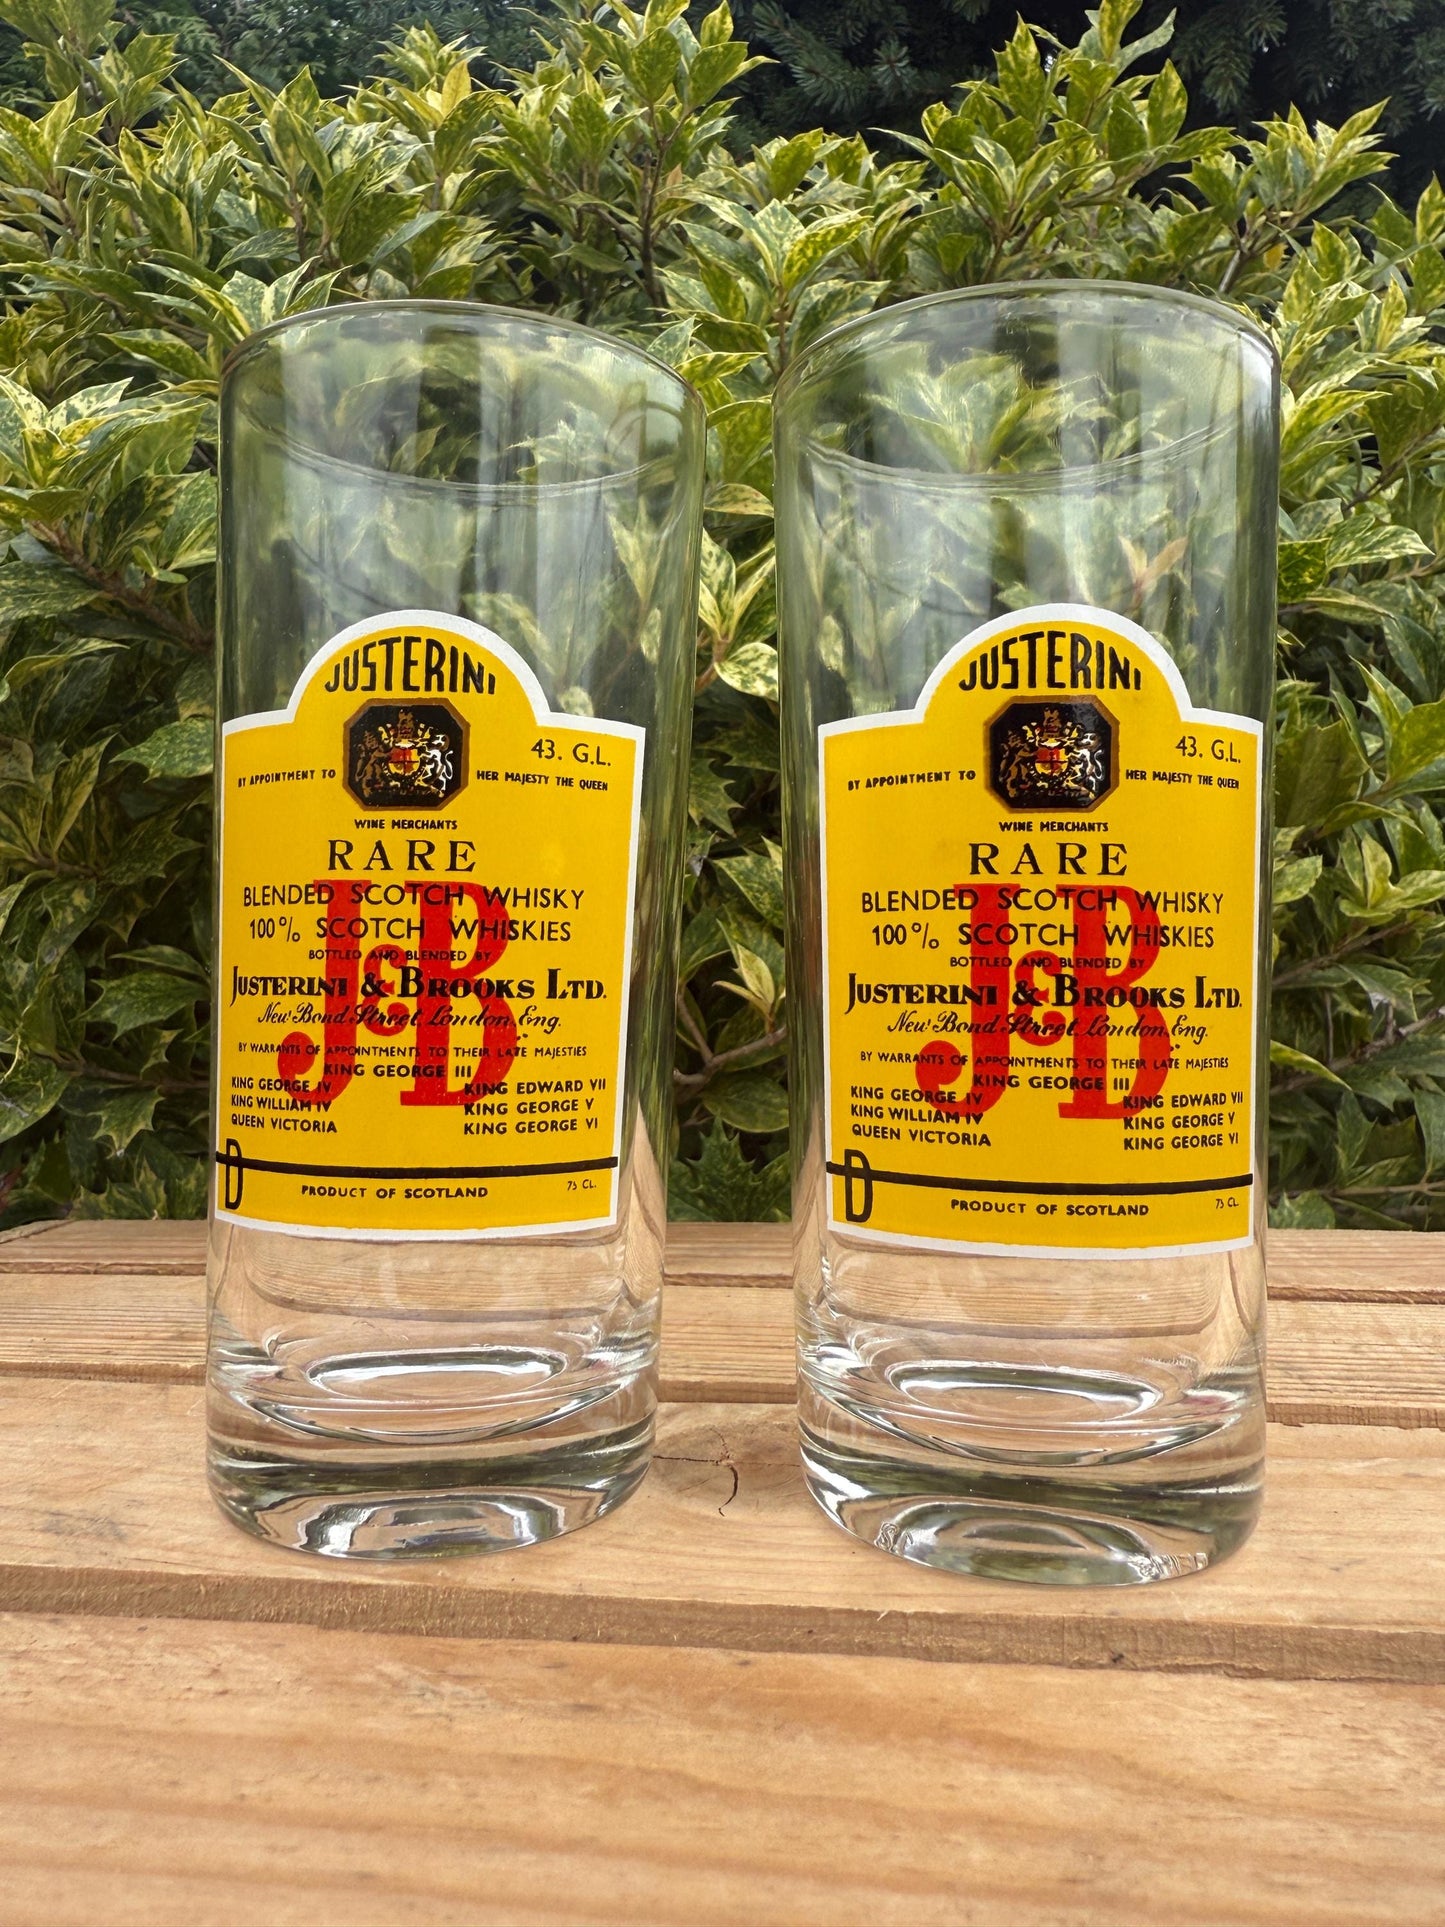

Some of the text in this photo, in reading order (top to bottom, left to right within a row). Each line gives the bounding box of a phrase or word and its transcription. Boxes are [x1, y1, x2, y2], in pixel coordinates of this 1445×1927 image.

[325, 636, 496, 695] JUSTERINI
[959, 631, 1142, 692] JUSTERINI
[532, 739, 610, 765] 43. G.L.
[1176, 736, 1240, 763] 43. G.L.
[238, 769, 336, 788] BY APPOINTMENT TO
[476, 770, 608, 791] HER MAJESTY THE QUEEN
[847, 770, 976, 791] BY APPOINTMENT TO
[1125, 769, 1240, 789] HER MAJESTY THE QUEEN
[354, 819, 458, 830] WINE MERCHANTS
[998, 821, 1109, 832] WINE MERCHANTS
[329, 840, 475, 872] RARE
[969, 843, 1127, 875] RARE
[244, 883, 583, 909] BLENDED SCOTCH WHISKY
[863, 888, 1223, 913] BLENDED SCOTCH WHISKY
[250, 917, 570, 942] 100% SCOTCH WHISKIES
[873, 923, 1213, 949] 100% SCOTCH WHISKIES
[308, 948, 491, 962] BOTTLED AND BLENDED BY
[949, 956, 1144, 969] BOTTLED AND BLENDED BY
[361, 972, 388, 998] &
[1012, 980, 1042, 1006] &
[290, 1003, 350, 1024] Bond
[933, 1011, 1000, 1034] Bond
[238, 1041, 587, 1060] BY WARRANTS OF APPOINTMENTS TO THEIR LATE MAJESTIES
[860, 1050, 1229, 1071] BY WARRANTS OF APPOINTMENTS TO THEIR LATE MAJESTIES
[323, 1062, 472, 1079] KING GEORGE III
[231, 1076, 332, 1094] KING GEORGE IV
[463, 1078, 606, 1097] KING EDWARD VII
[972, 1073, 1130, 1091] KING GEORGE III
[231, 1094, 332, 1113] KING WILLIAM IV
[850, 1085, 983, 1105] KING GEORGE IV
[1122, 1091, 1243, 1110] KING EDWARD VII
[463, 1097, 594, 1116] KING GEORGE V
[850, 1103, 984, 1125] KING WILLIAM IV
[231, 1113, 338, 1133] QUEEN VICTORIA
[463, 1117, 598, 1135] KING GEORGE VI
[1123, 1111, 1235, 1130] KING GEORGE V
[851, 1123, 991, 1146] QUEEN VICTORIA
[1123, 1132, 1239, 1151] KING GEORGE VI
[301, 1184, 488, 1199] PRODUCT OF SCOTLAND
[582, 1179, 597, 1190] CL.
[950, 1198, 1149, 1217] PRODUCT OF SCOTLAND
